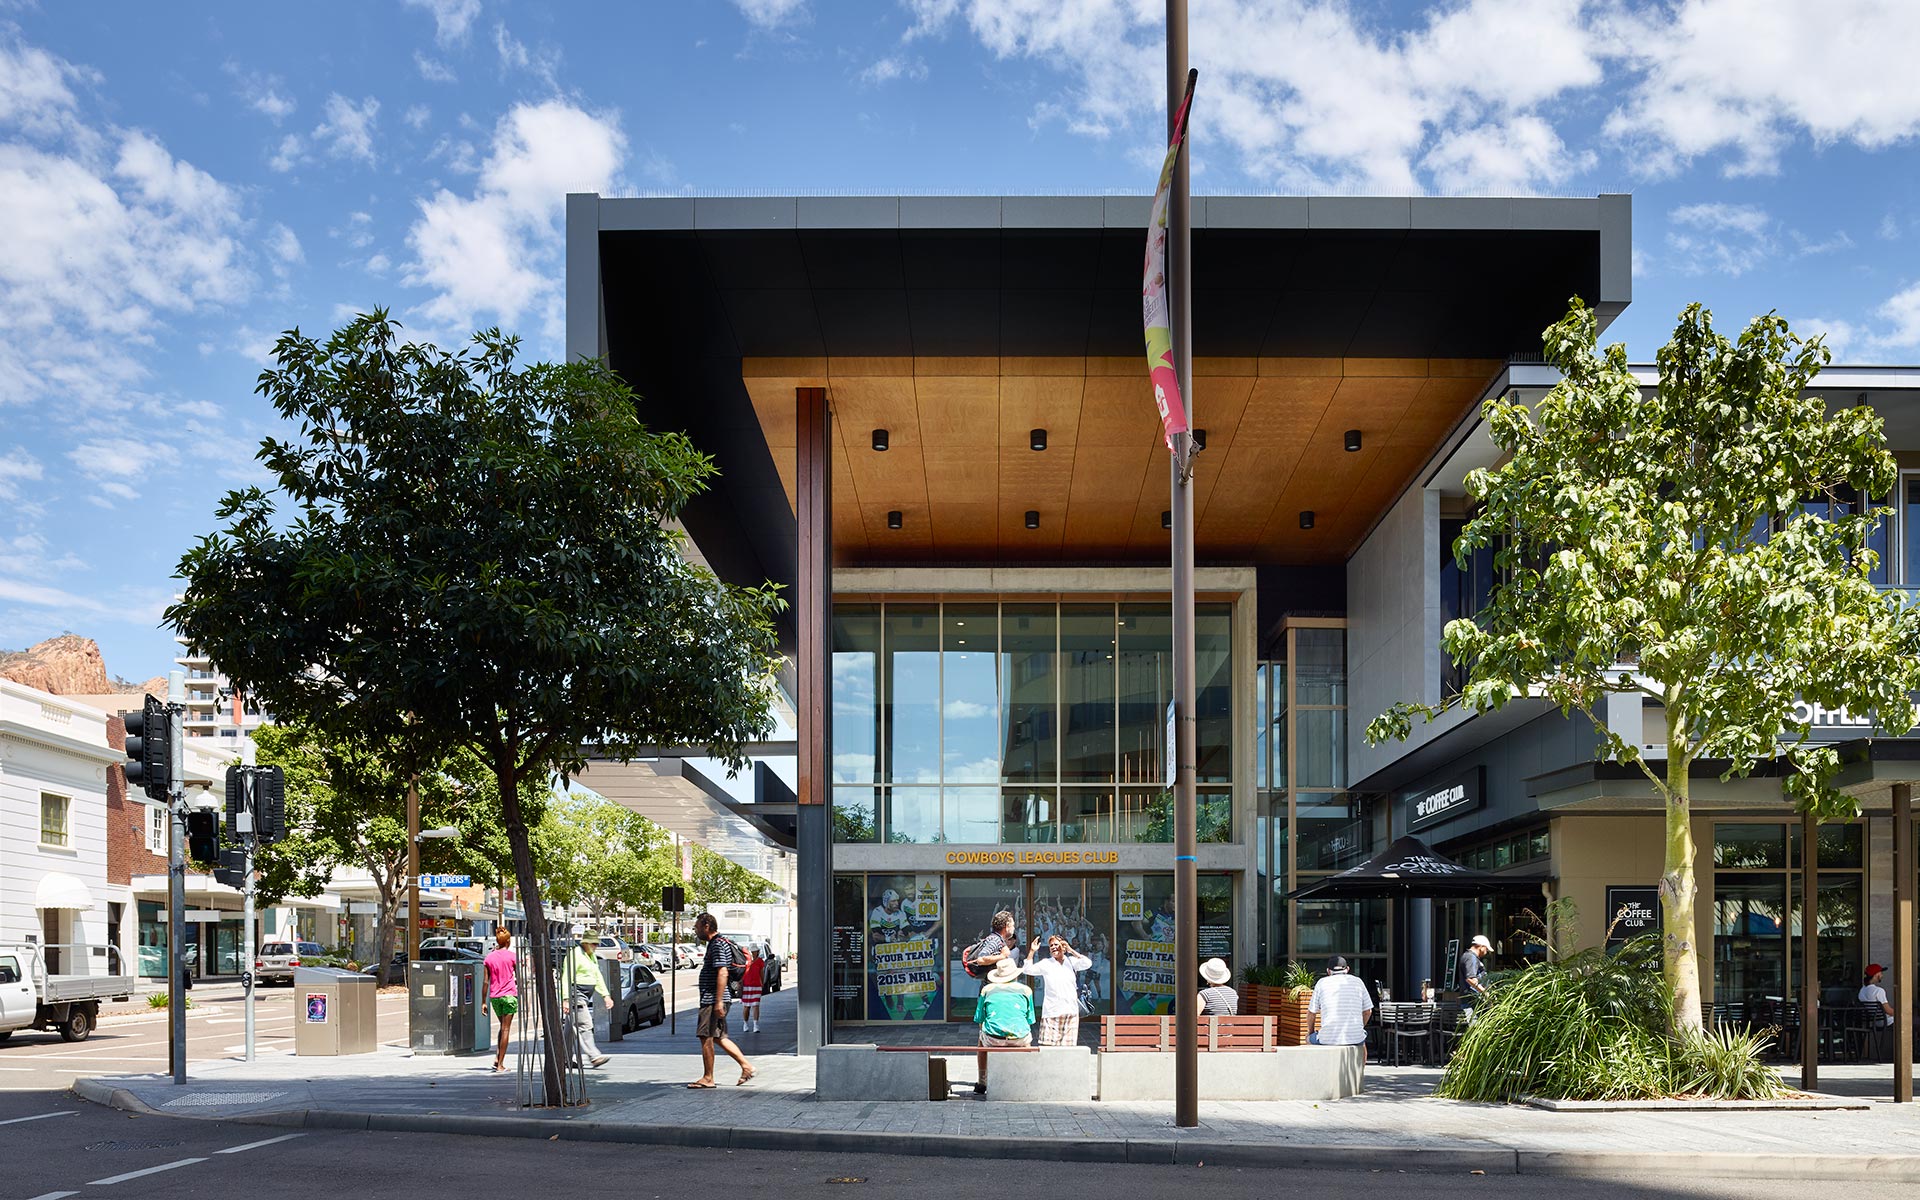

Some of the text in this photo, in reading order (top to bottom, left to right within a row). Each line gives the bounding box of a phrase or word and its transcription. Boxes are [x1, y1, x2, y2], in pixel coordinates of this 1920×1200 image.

[1426, 789, 1449, 814] COFFEE
[1449, 784, 1464, 802] CLUB
[946, 851, 1118, 864] COWBOYS LEAGUES CLUB
[1385, 862, 1466, 871] COFFEE
[434, 875, 464, 884] FLINDERS
[919, 902, 938, 915] GO
[1122, 902, 1141, 915] GO
[1617, 909, 1652, 918] COFFEE
[876, 940, 932, 955] SUPPORT
[1128, 941, 1175, 953] SUPPOR
[877, 951, 933, 963] YOUR TEAM
[1127, 951, 1175, 962] YOUR TEA
[914, 959, 934, 967] CLUB
[878, 971, 935, 986] 2015 NRL
[1124, 971, 1175, 984] 2015 NR
[879, 982, 936, 995] PREMIERS
[1123, 983, 1175, 993] PREMIER
